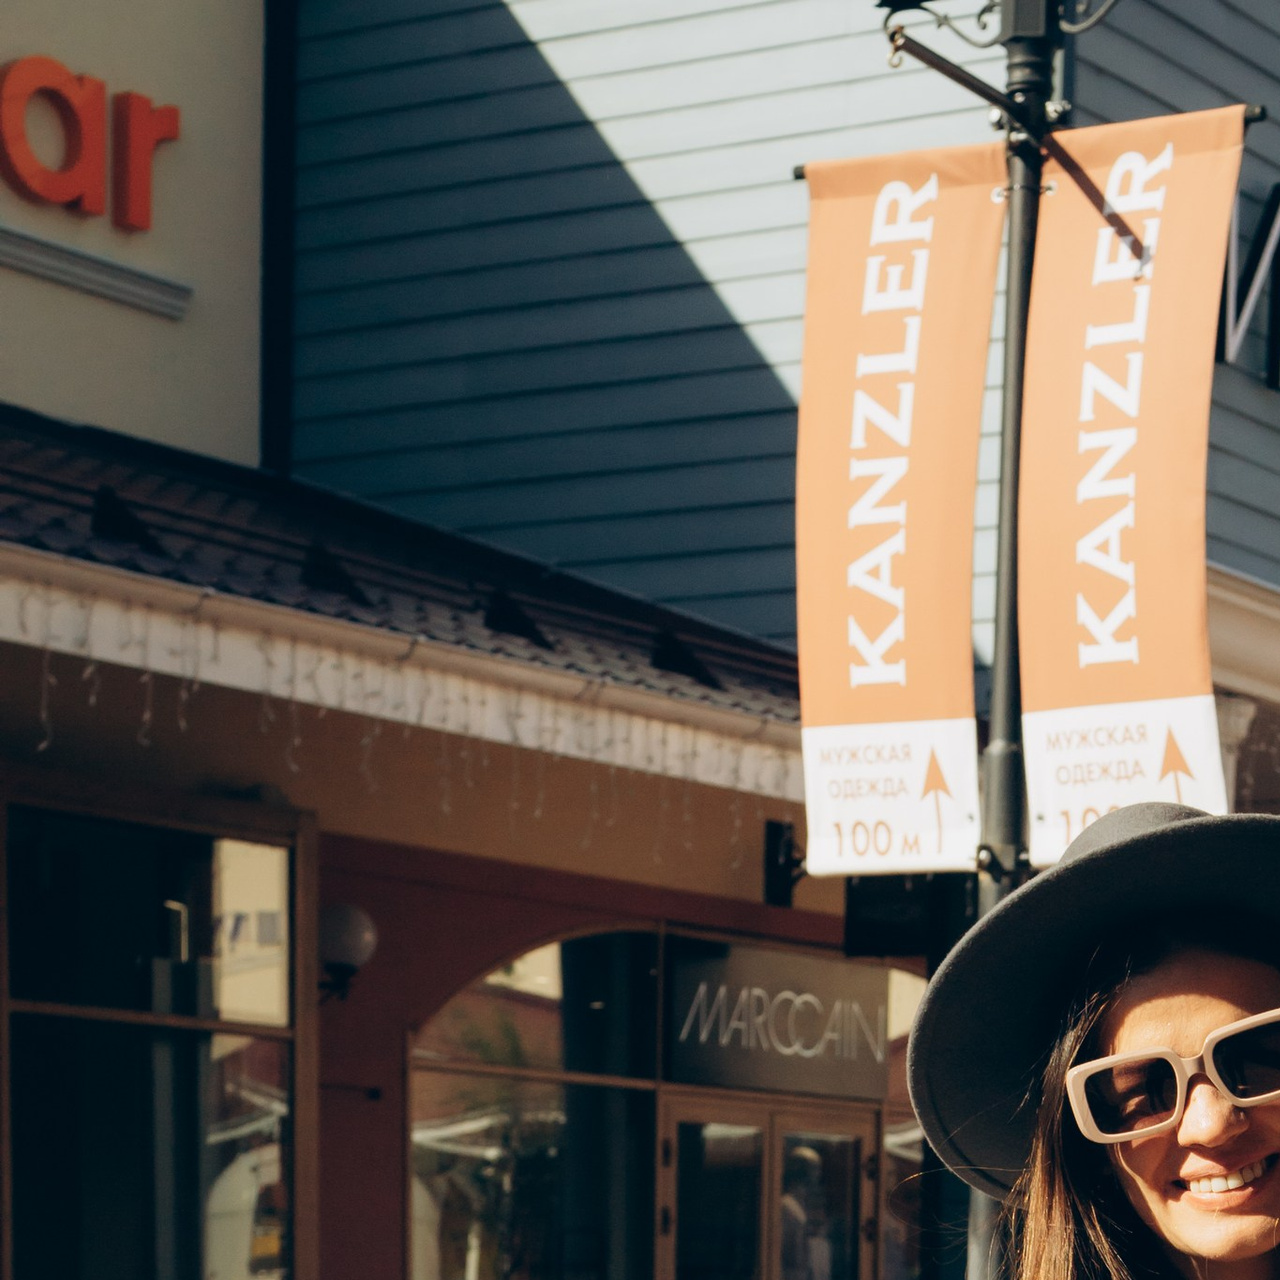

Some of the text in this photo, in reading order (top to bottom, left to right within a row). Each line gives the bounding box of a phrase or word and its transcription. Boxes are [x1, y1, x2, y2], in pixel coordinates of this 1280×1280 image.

[1075, 142, 1174, 670] KANZLER
[847, 173, 938, 688] KANZLER
[1045, 724, 1148, 751] МУЖСКАЯ
[820, 743, 913, 765] МУЖСКАЯ
[1056, 759, 1146, 786] ОДЕЖДА
[828, 777, 909, 799] ОДЕЖДА
[834, 819, 892, 856] 100
